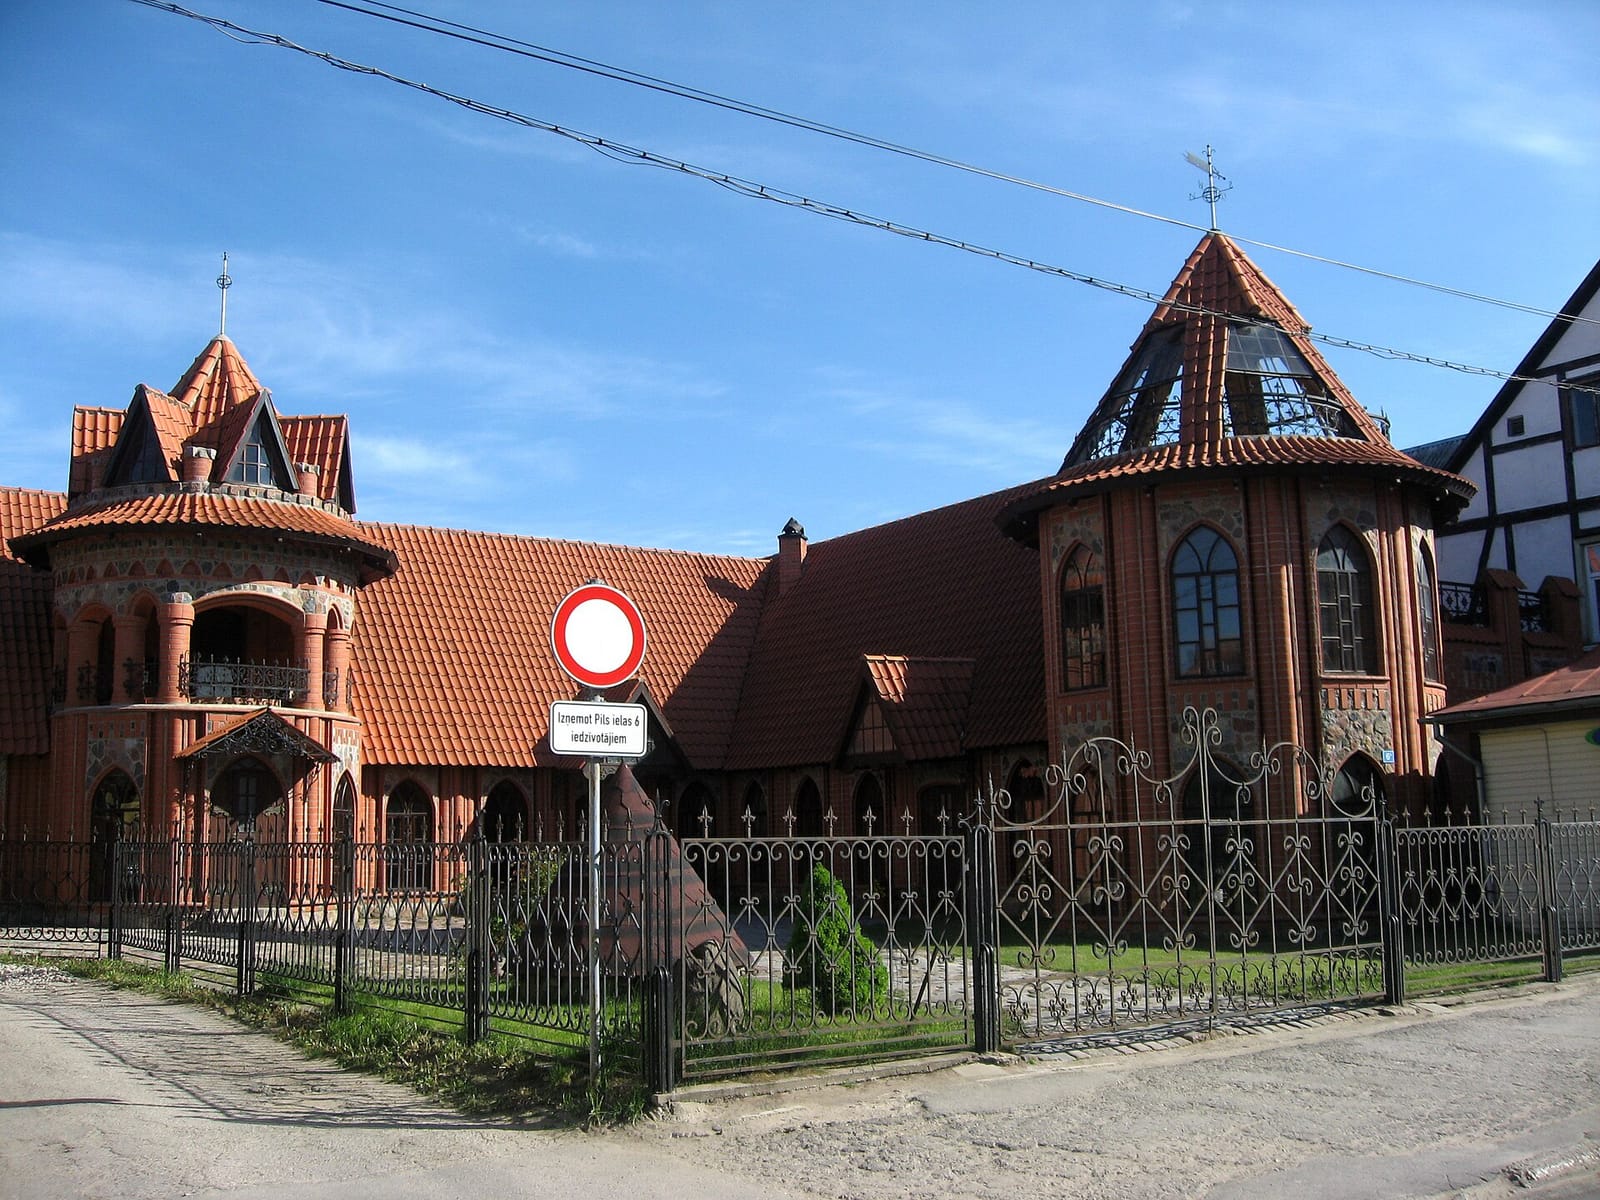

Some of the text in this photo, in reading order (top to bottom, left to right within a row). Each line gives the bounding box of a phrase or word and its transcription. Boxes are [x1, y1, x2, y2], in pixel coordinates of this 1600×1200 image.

[558, 712, 640, 727] Izņemot Pils ielas 6
[571, 731, 626, 746] iedzīvotājiem
